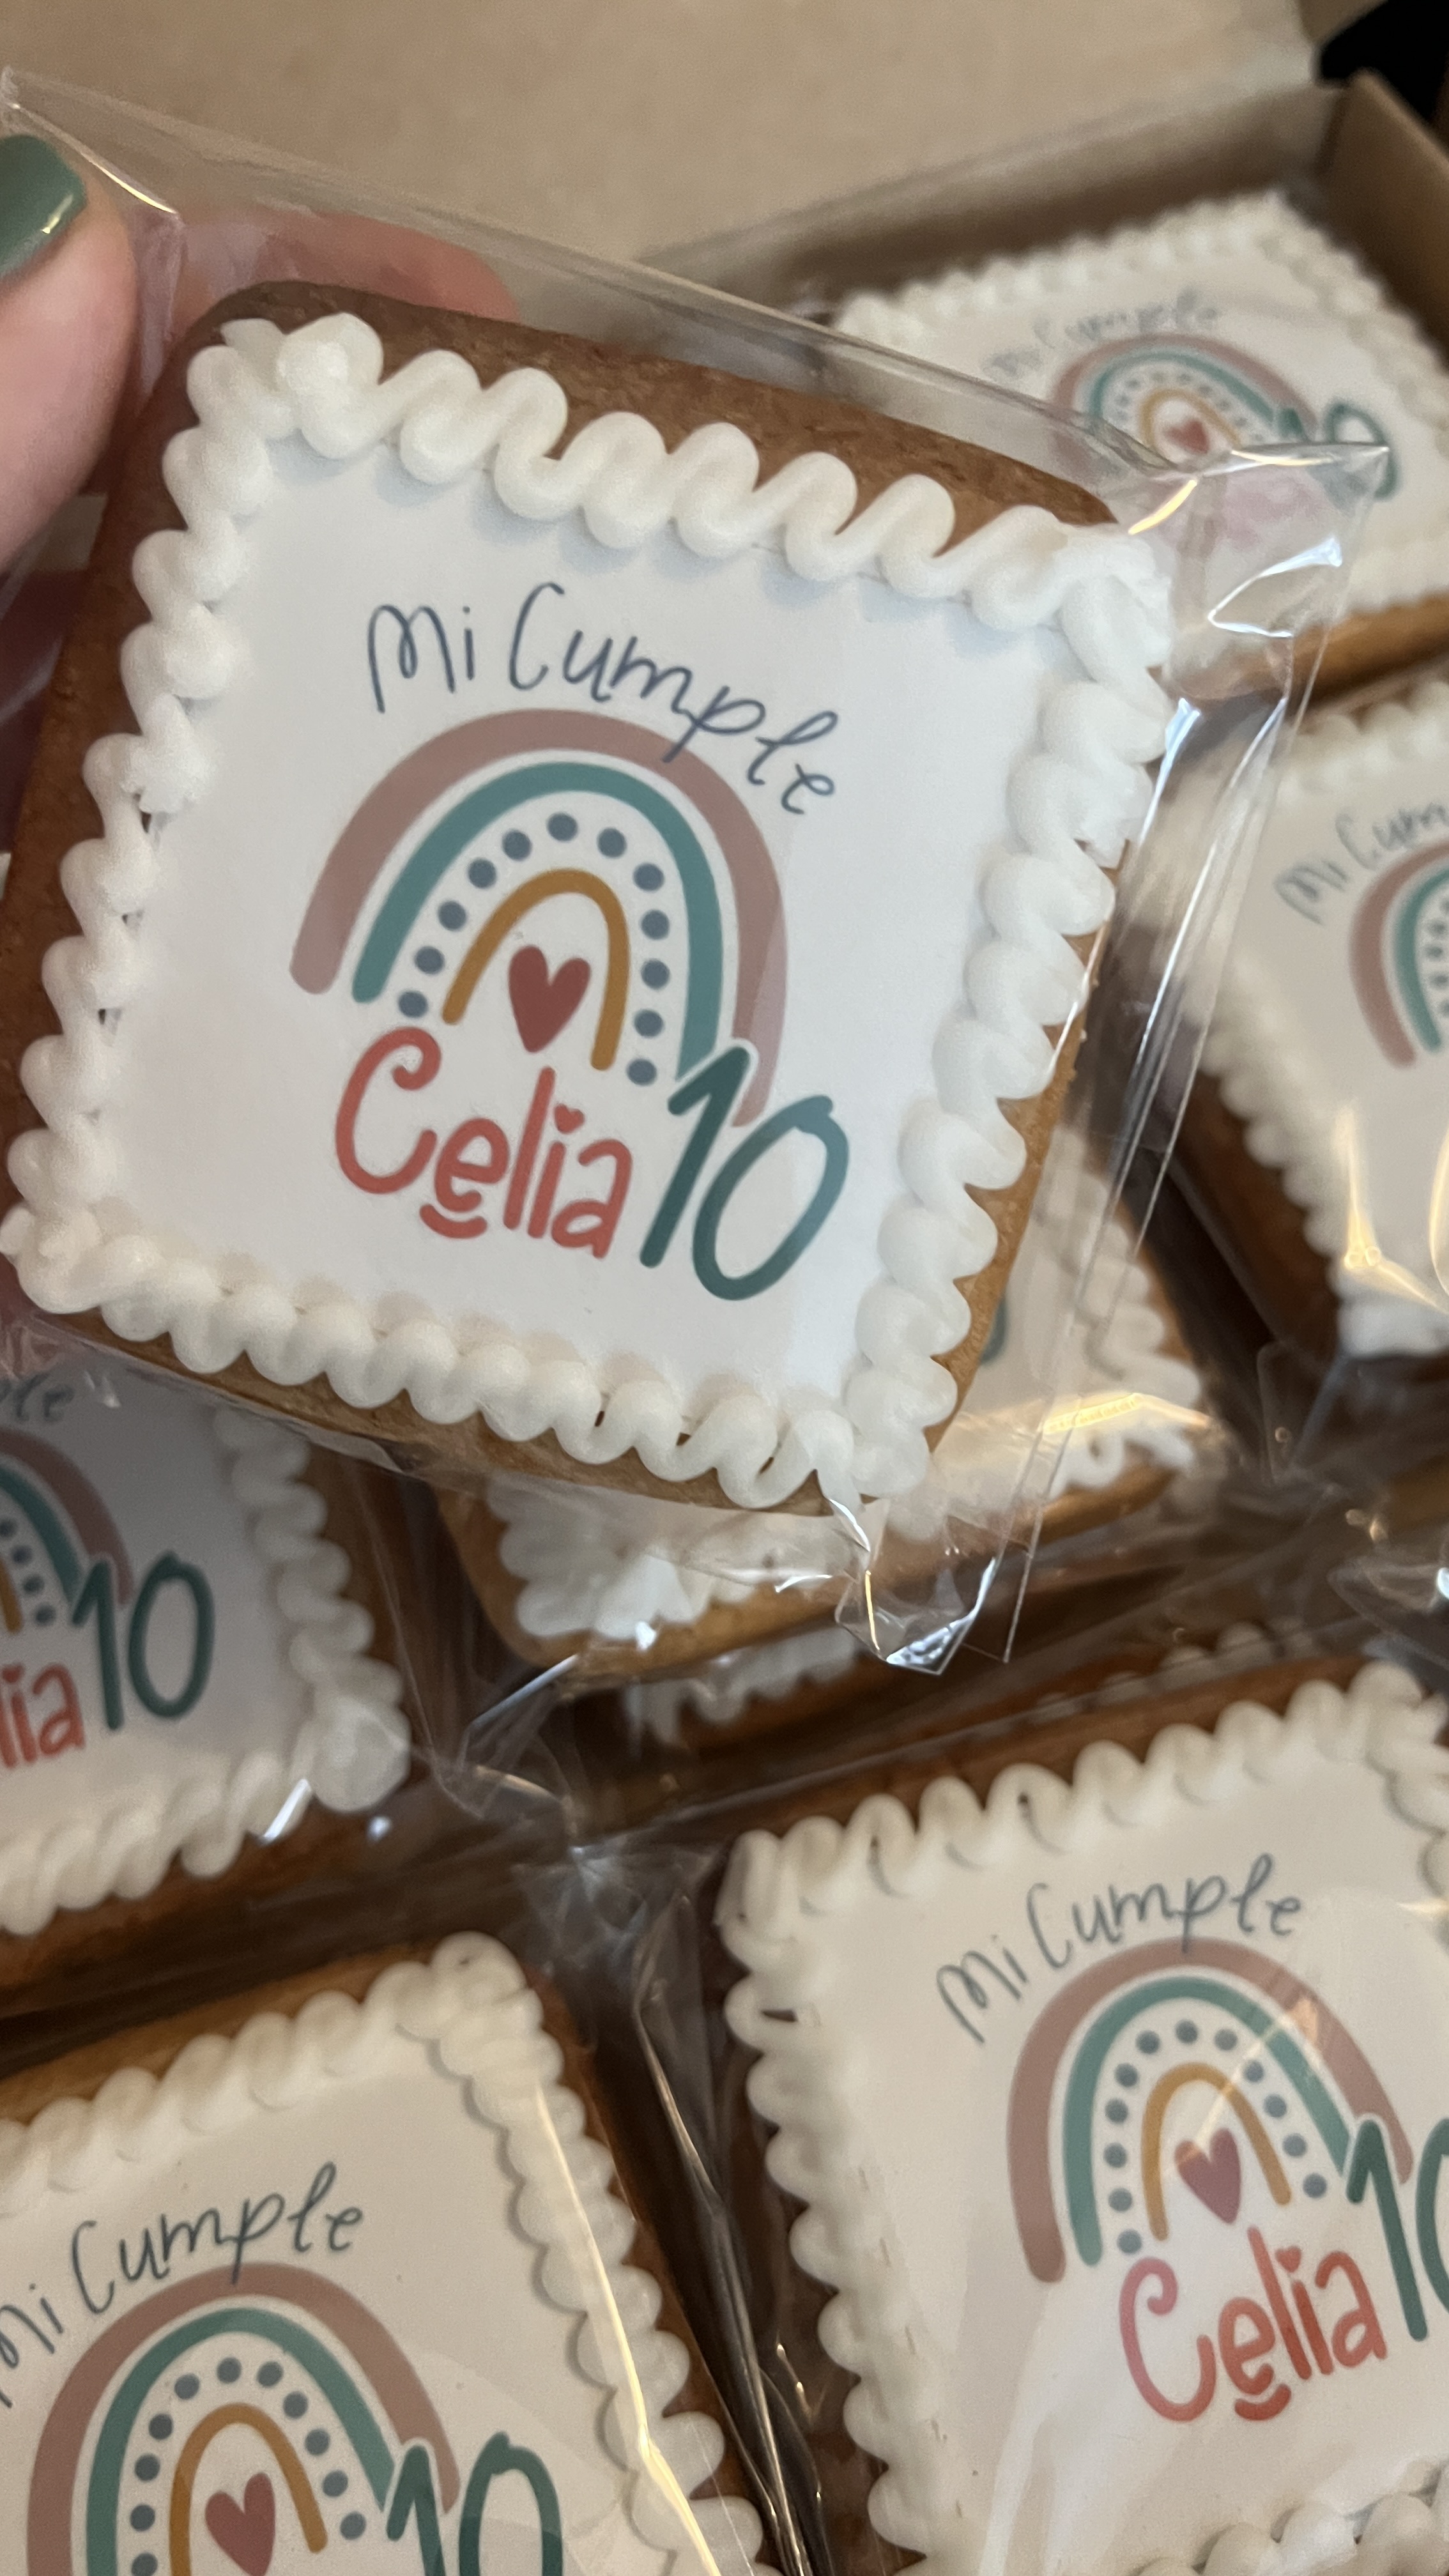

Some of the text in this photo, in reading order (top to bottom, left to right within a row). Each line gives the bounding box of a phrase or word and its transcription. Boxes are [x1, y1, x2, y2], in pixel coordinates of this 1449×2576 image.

[367, 581, 838, 815] Mi Cumple
[335, 1026, 850, 1301] Celia 10
[72, 1549, 215, 1730] 10
[936, 1853, 1302, 2044] Mi Cumple
[72, 2161, 363, 2314] Cumple
[1119, 2225, 1388, 2423] Celia
